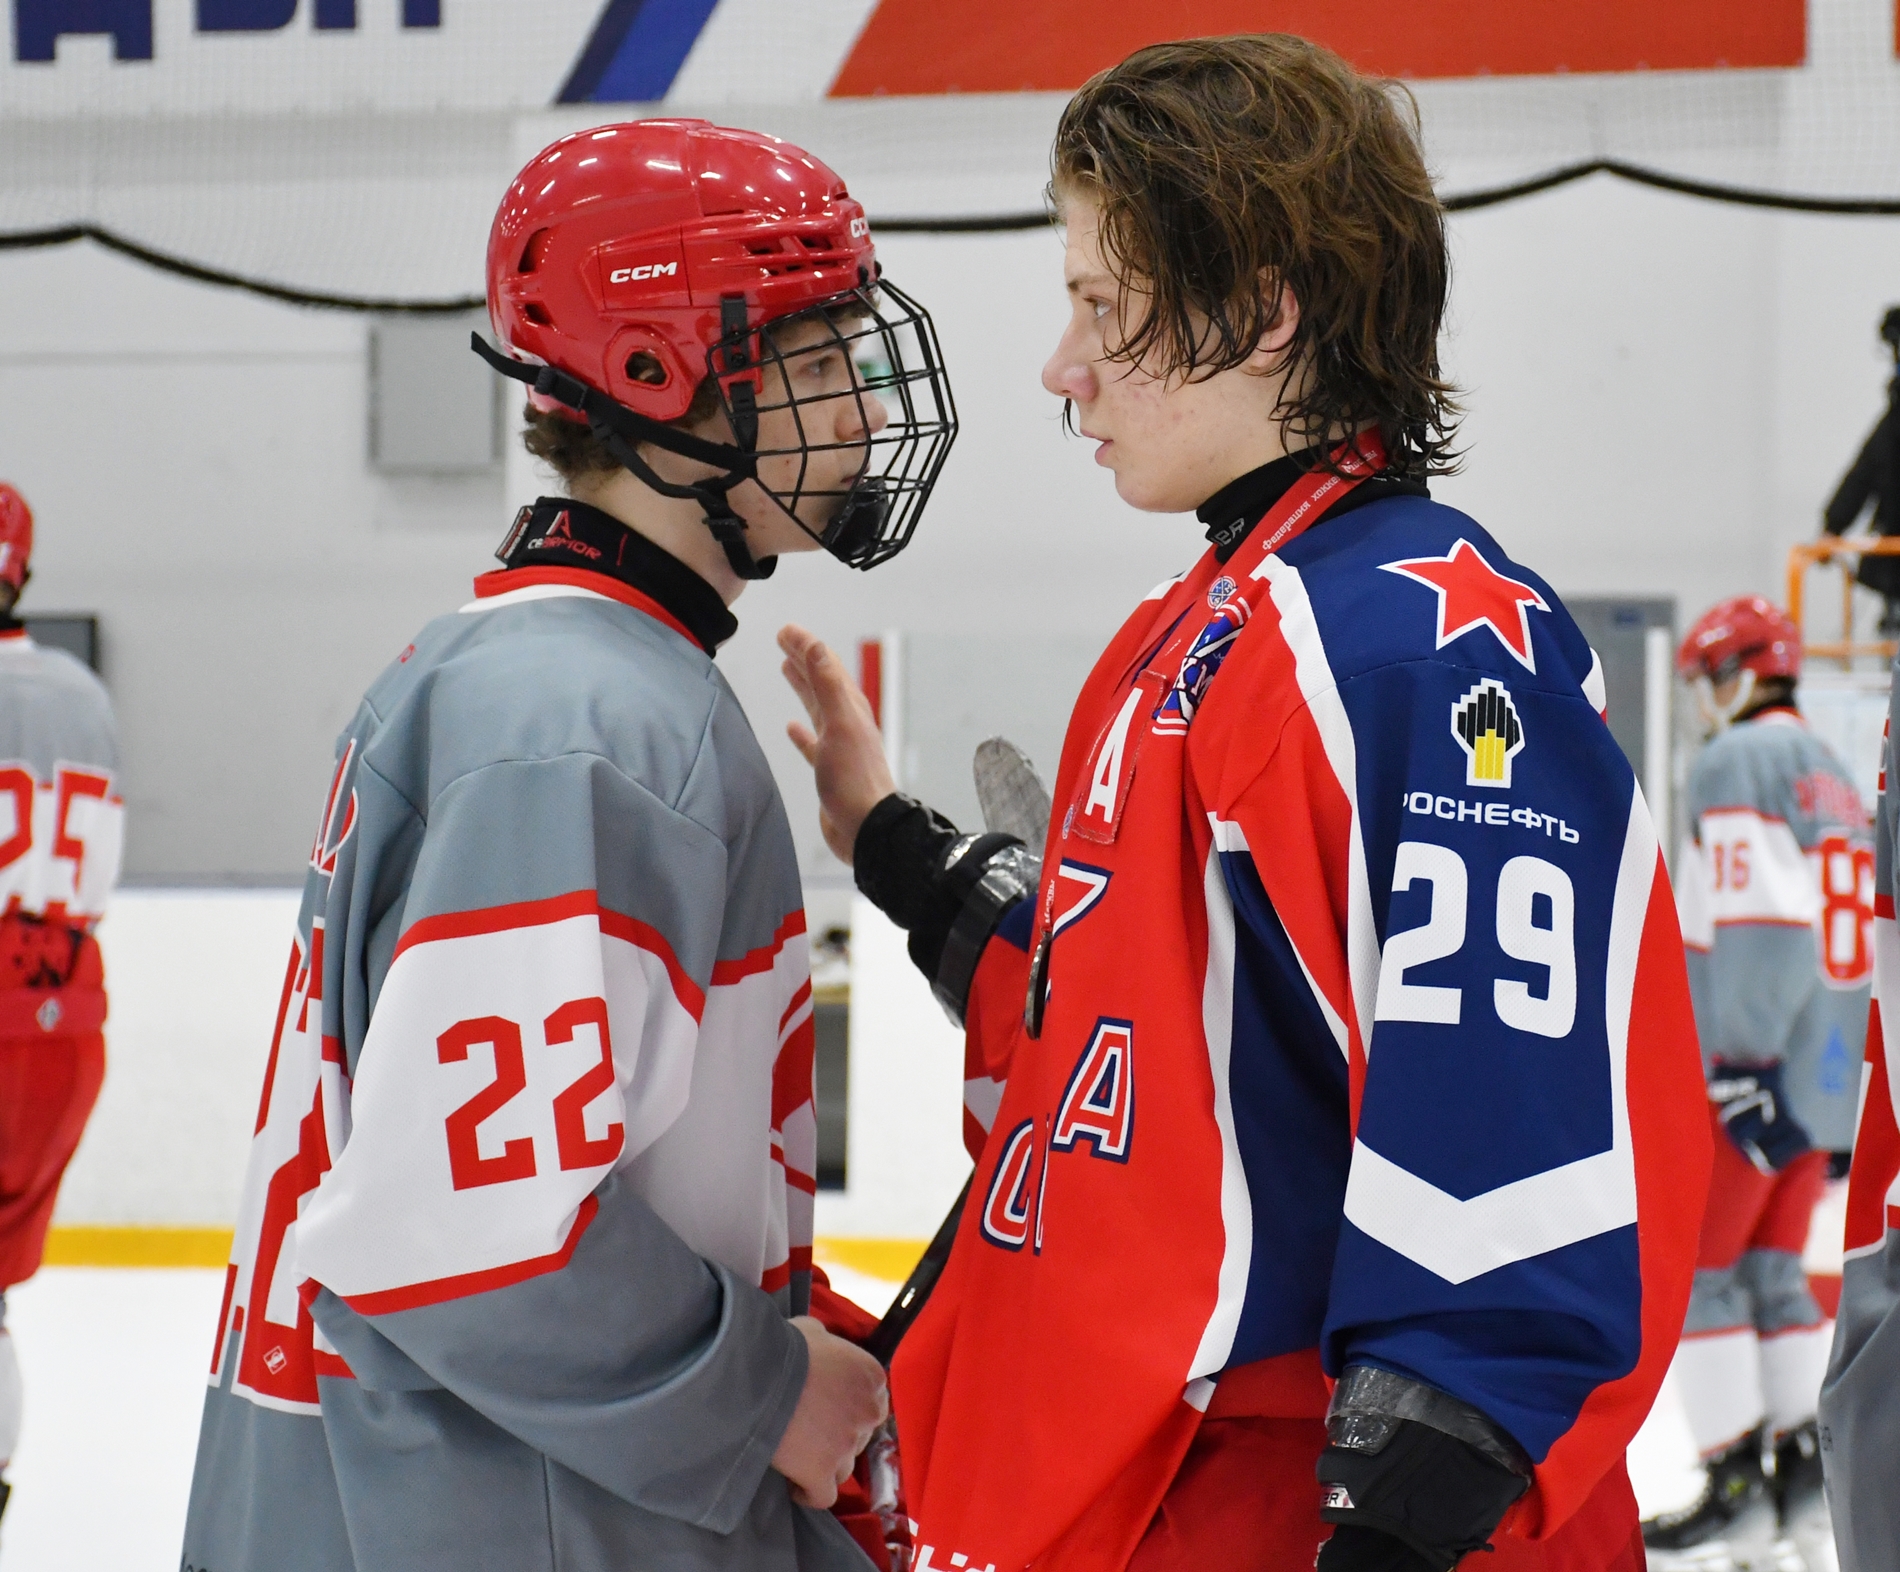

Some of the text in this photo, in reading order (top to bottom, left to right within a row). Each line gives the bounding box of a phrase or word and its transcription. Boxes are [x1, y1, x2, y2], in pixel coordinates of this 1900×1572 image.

[850, 217, 870, 238] CC
[610, 262, 678, 284] CCM
[1262, 501, 1311, 550] Федерация
[1311, 475, 1341, 502] хокке
[1084, 687, 1144, 824] А
[1402, 791, 1580, 844] ОСНЕФТЬ
[1374, 841, 1577, 1039] 29
[436, 996, 625, 1191] 22
